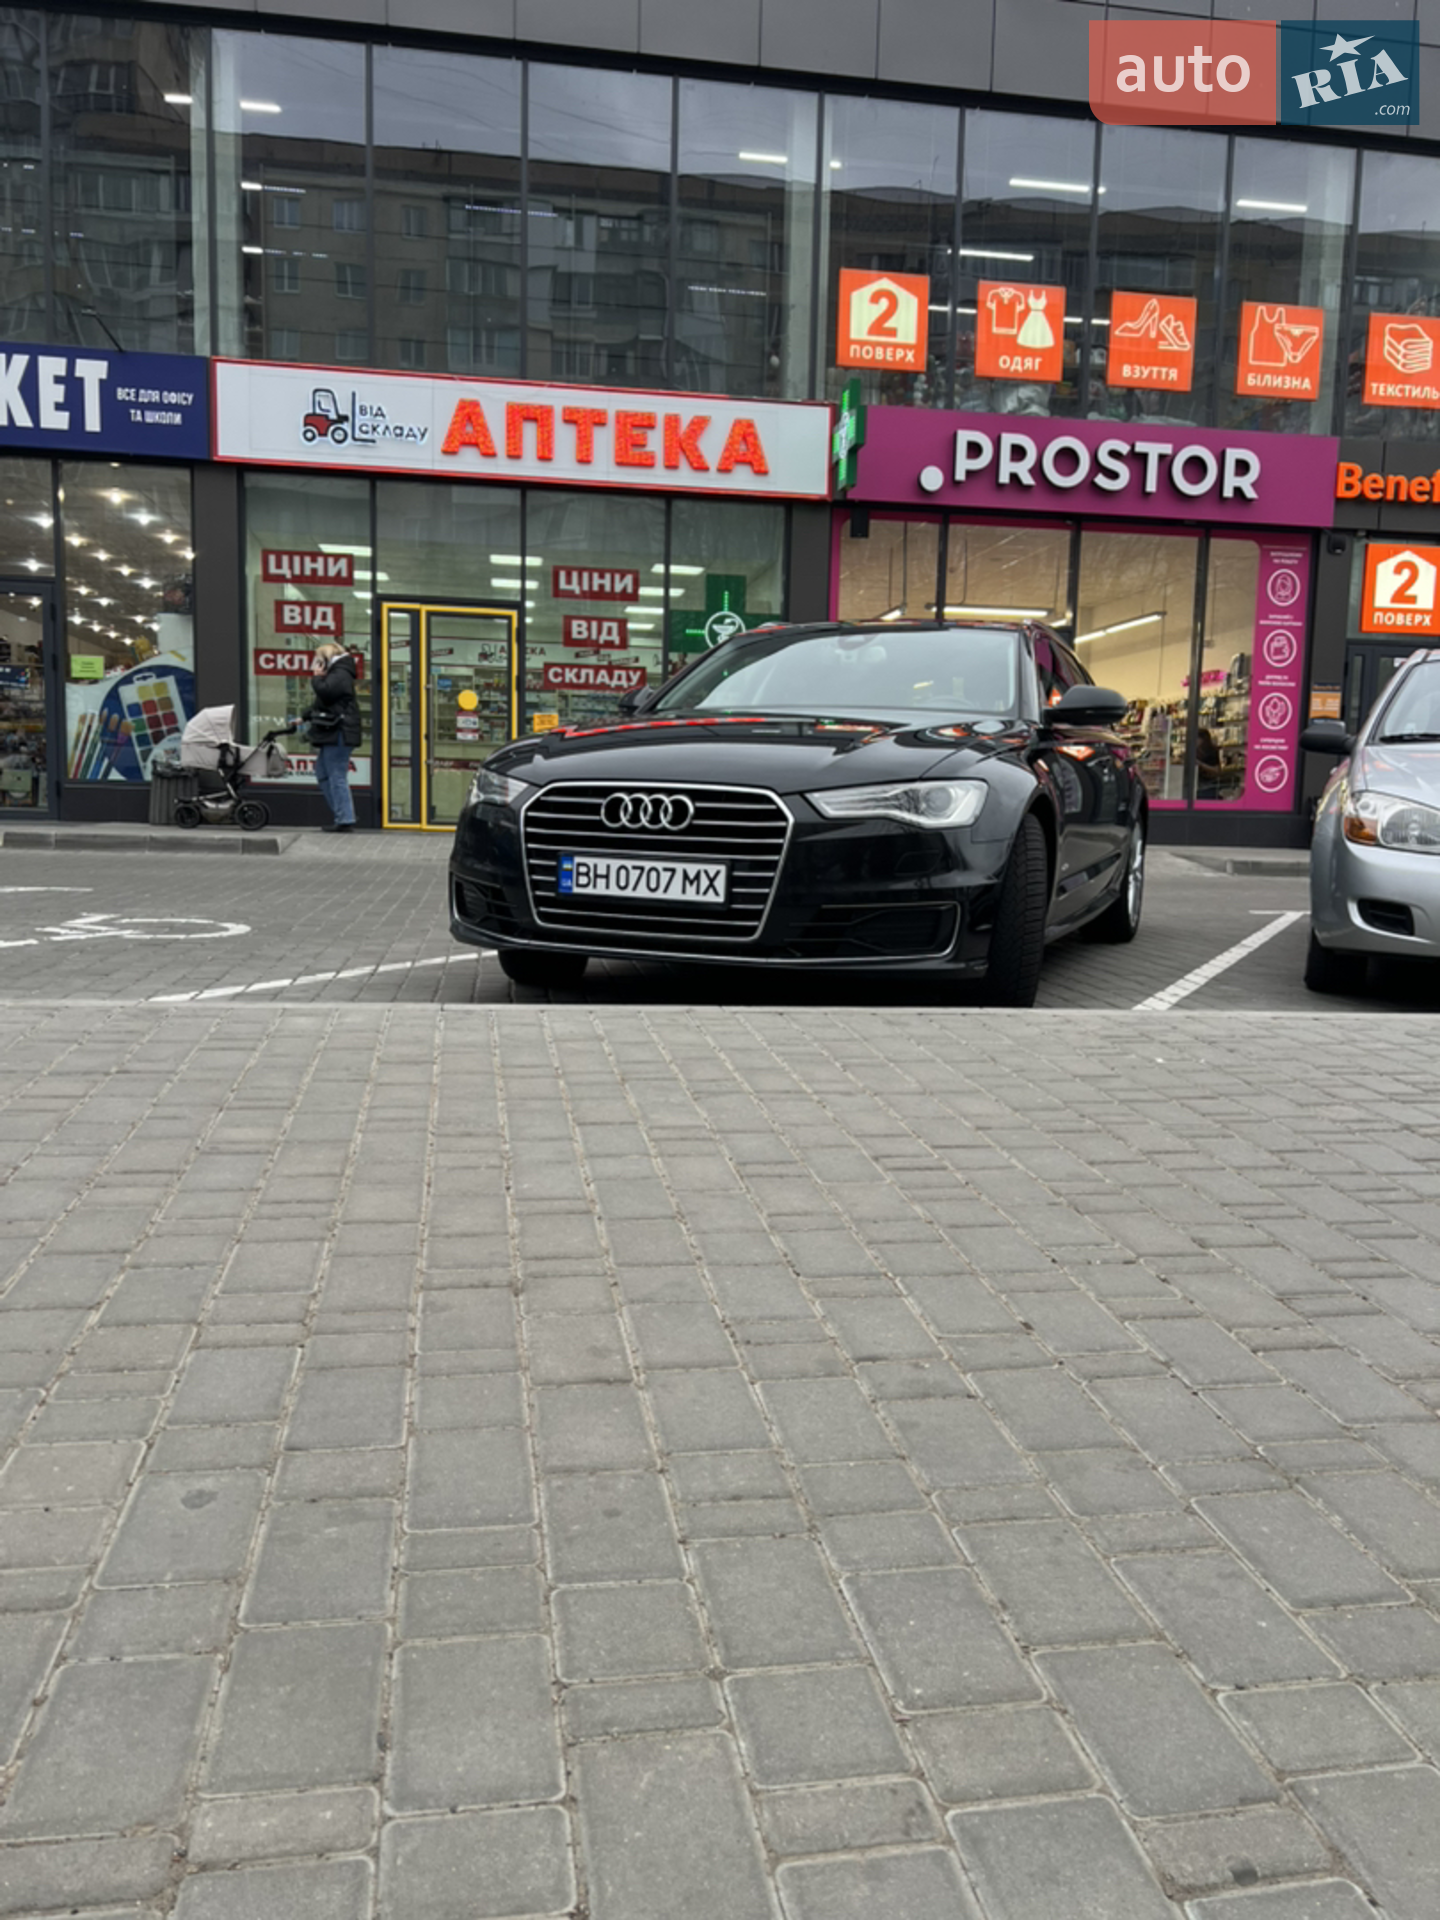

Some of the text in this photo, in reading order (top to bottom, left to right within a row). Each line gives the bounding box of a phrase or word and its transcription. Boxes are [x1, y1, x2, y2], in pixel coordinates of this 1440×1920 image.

[866, 288, 899, 338] 2
[849, 344, 915, 363] ПОВЕРХ
[998, 354, 1043, 373] ОДЯГ
[1122, 363, 1178, 382] ВЗУТТЯ
[1246, 372, 1313, 391] БІЛИЗНА
[1370, 382, 1440, 400] ТЕКСТИЛЬ
[116, 387, 194, 406] ВСЕ ДЛЯ ОФІСУ
[129, 408, 182, 425] ТА ШКОЛИ
[359, 404, 386, 418] ВІД
[441, 397, 770, 475] АПТЕКА
[268, 554, 349, 579] ЦІНИ
[558, 569, 634, 595] ЦІНИ
[1389, 560, 1420, 606] 2
[283, 604, 335, 631] ВІД
[1373, 611, 1432, 627] ПОВЕРХ
[571, 619, 620, 645] ВІД
[548, 667, 642, 688] СКЛАДУ
